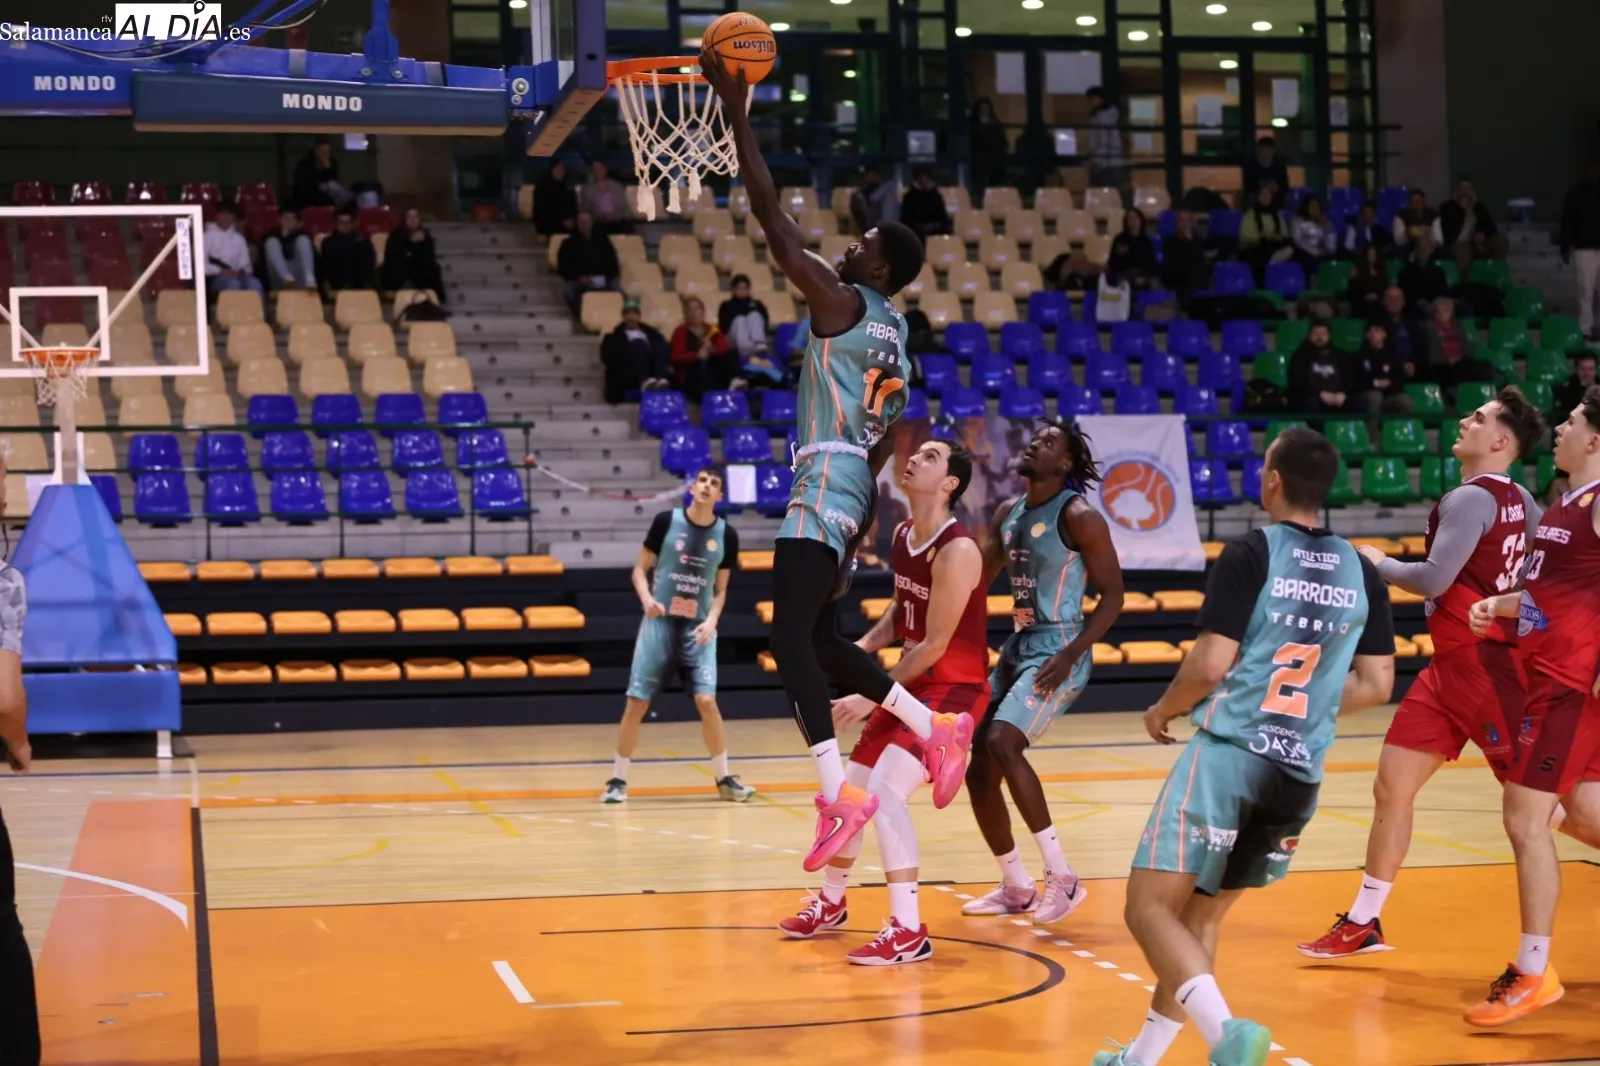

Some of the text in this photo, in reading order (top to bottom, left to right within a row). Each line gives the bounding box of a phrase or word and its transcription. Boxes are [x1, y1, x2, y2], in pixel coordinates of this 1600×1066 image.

[733, 40, 775, 53] Wilson
[34, 75, 116, 91] MONDO
[282, 93, 363, 112] MONDO
[1271, 577, 1358, 608] BARROSO
[1260, 642, 1321, 719] 2
